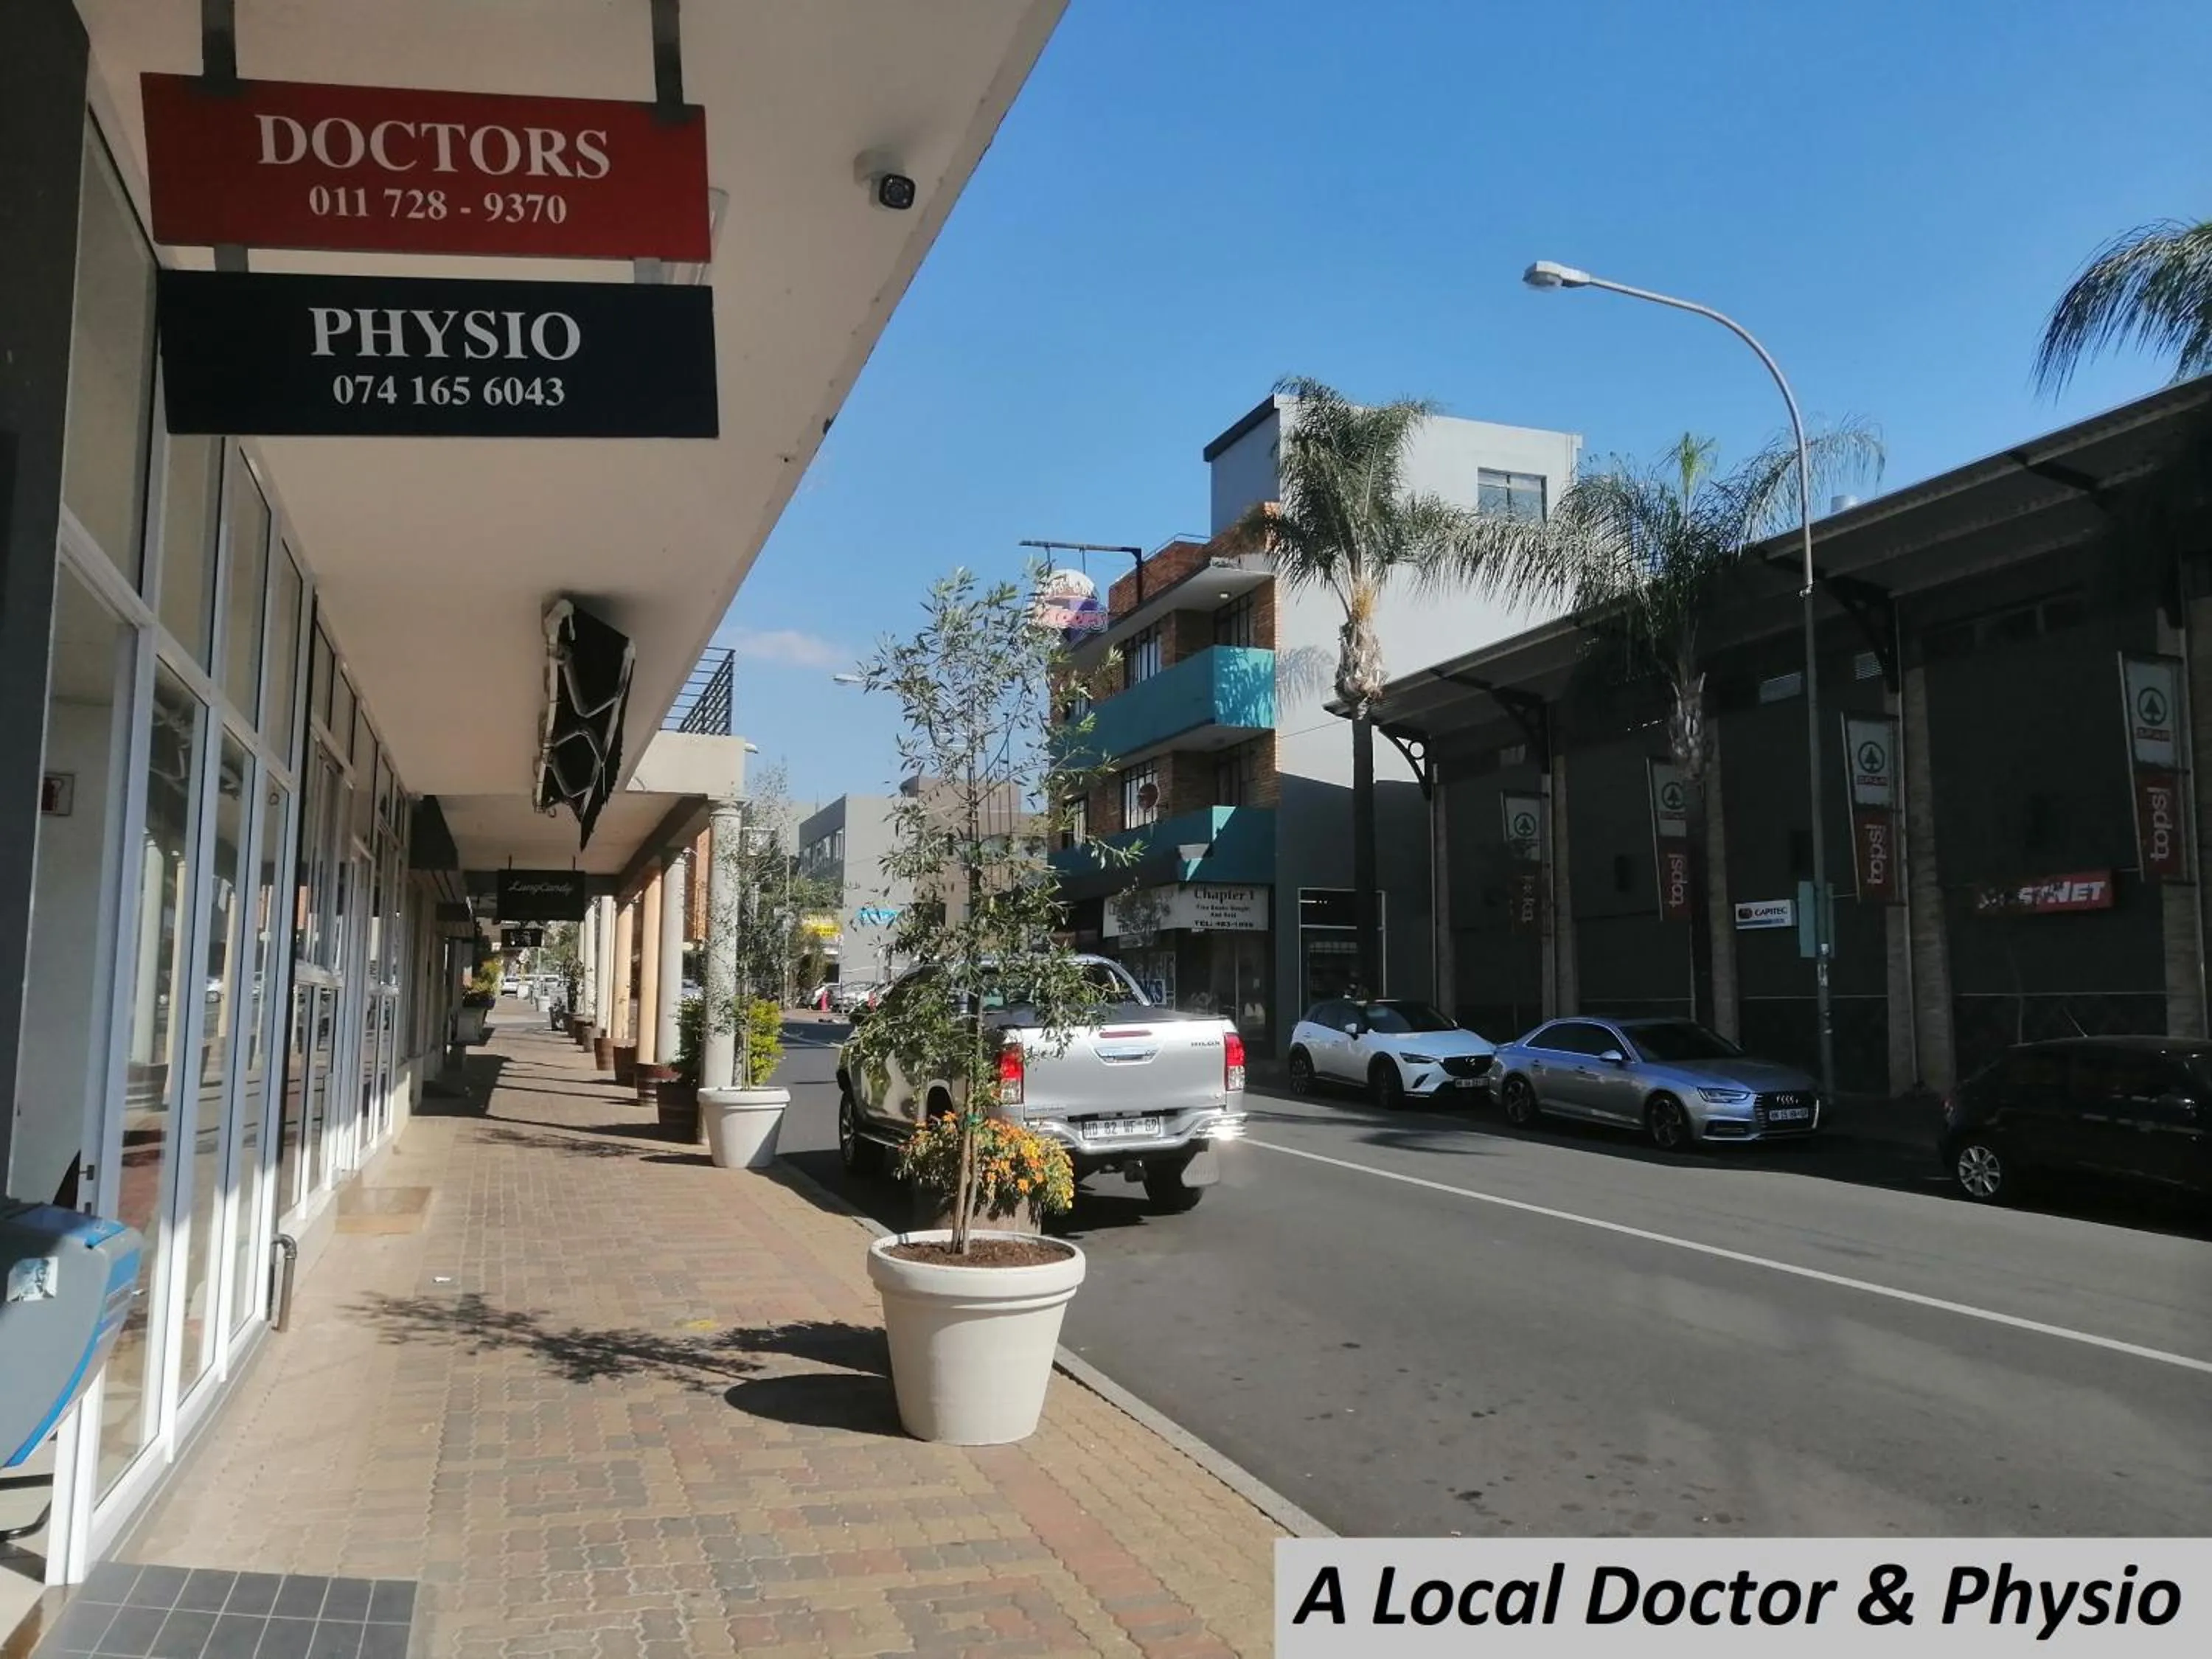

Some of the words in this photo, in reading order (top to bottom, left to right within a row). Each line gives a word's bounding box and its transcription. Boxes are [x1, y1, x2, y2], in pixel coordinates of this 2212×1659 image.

[255, 114, 611, 179] DOCTORS
[309, 186, 368, 218] 011
[383, 187, 448, 220] 728
[484, 192, 568, 224] 9370
[308, 307, 581, 361] PHYSIO
[333, 375, 397, 405] 074
[412, 375, 471, 406] 165
[483, 376, 566, 407] 6043
[1194, 887, 1245, 903] Chapter
[1754, 906, 1788, 917] CAPITEC
